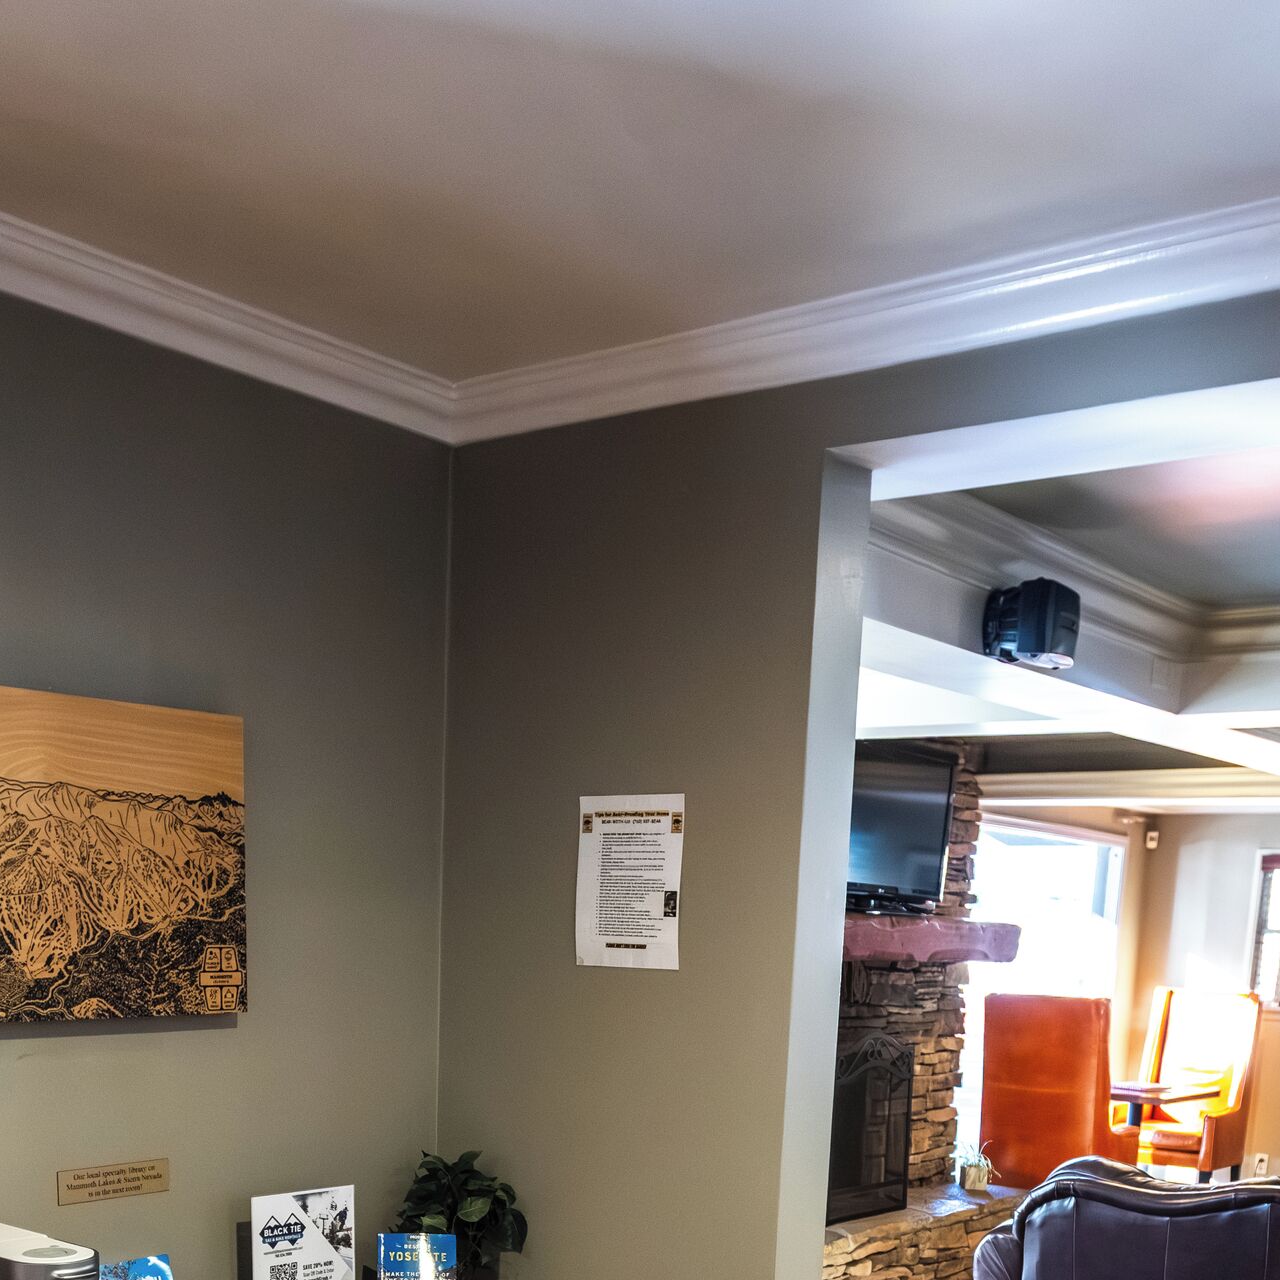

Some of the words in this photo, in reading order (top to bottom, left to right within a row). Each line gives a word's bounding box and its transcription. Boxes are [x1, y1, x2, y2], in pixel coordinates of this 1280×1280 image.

[86, 1171, 100, 1179] local
[102, 1169, 126, 1178] specialty
[128, 1166, 146, 1174] library
[66, 1181, 97, 1190] Mammoth
[142, 1173, 162, 1181] Nevada
[126, 1184, 143, 1192] room!
[264, 1226, 288, 1236] BLACK
[389, 1251, 447, 1262] YOSETE
